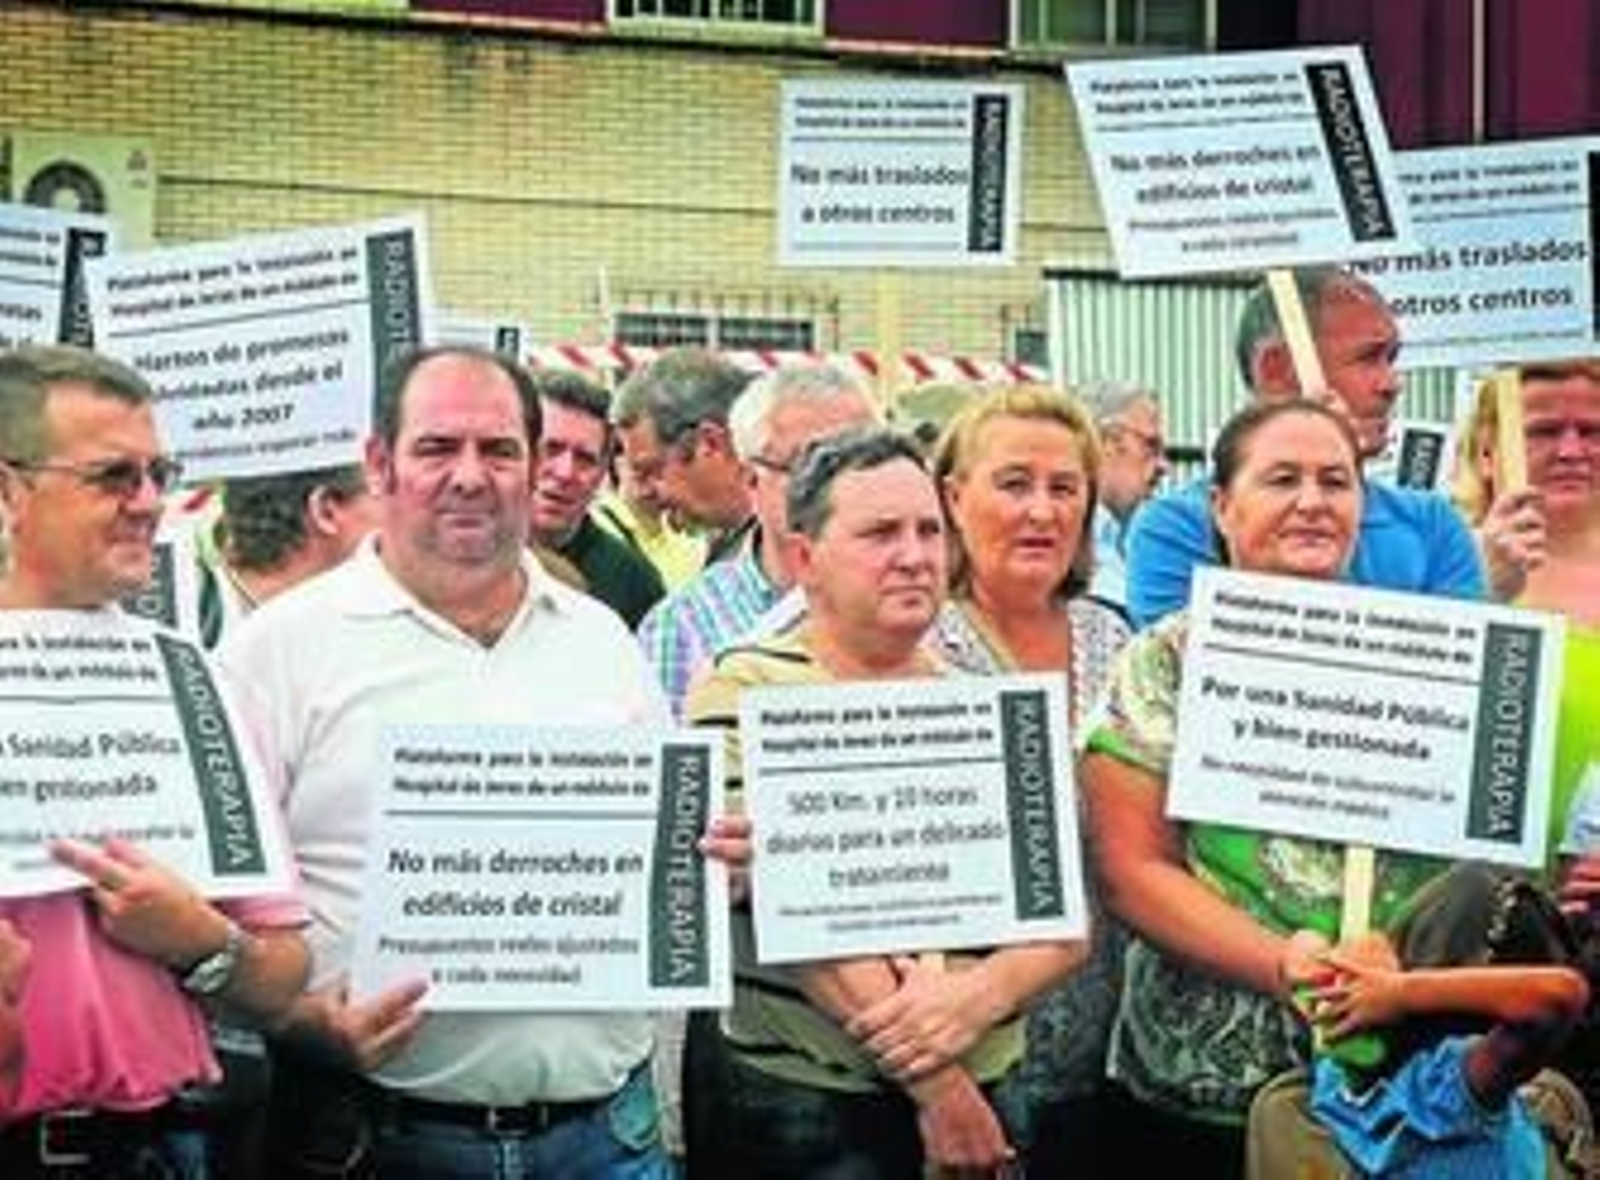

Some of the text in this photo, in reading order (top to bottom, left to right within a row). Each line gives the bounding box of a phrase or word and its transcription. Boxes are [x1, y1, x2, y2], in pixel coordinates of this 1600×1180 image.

[1110, 144, 1320, 171] No más derroches en
[1319, 66, 1385, 234] RADIOTERAPIA
[791, 163, 968, 185] No más traslados
[981, 101, 1000, 247] RADIOTERAPIA
[1136, 176, 1312, 203] edificios de cristal
[801, 204, 954, 223] a otros centros
[1396, 248, 1452, 270] más
[1459, 239, 1587, 266] traslados
[1389, 286, 1573, 316] otros centros
[213, 343, 241, 360] de
[246, 331, 349, 358] promesas
[255, 365, 315, 391] desde
[322, 362, 343, 380] el
[193, 404, 294, 430] año 2007
[1201, 677, 1471, 731] Por una Sanidad Pública
[7, 731, 181, 758] Sanidad Pública
[1233, 717, 1432, 760] y bien gestionada
[1488, 632, 1529, 836] RADIOTERAPIA
[177, 650, 252, 865] RADIOTERAPIA
[1015, 700, 1055, 911] RADIOTERAPIA
[767, 819, 1005, 854] diarios para un delicado
[388, 849, 644, 874] No más derroches en
[668, 757, 700, 980] RADIOTERAPIA
[828, 862, 949, 888] tratamiento
[403, 891, 622, 916] edificios de cristal
